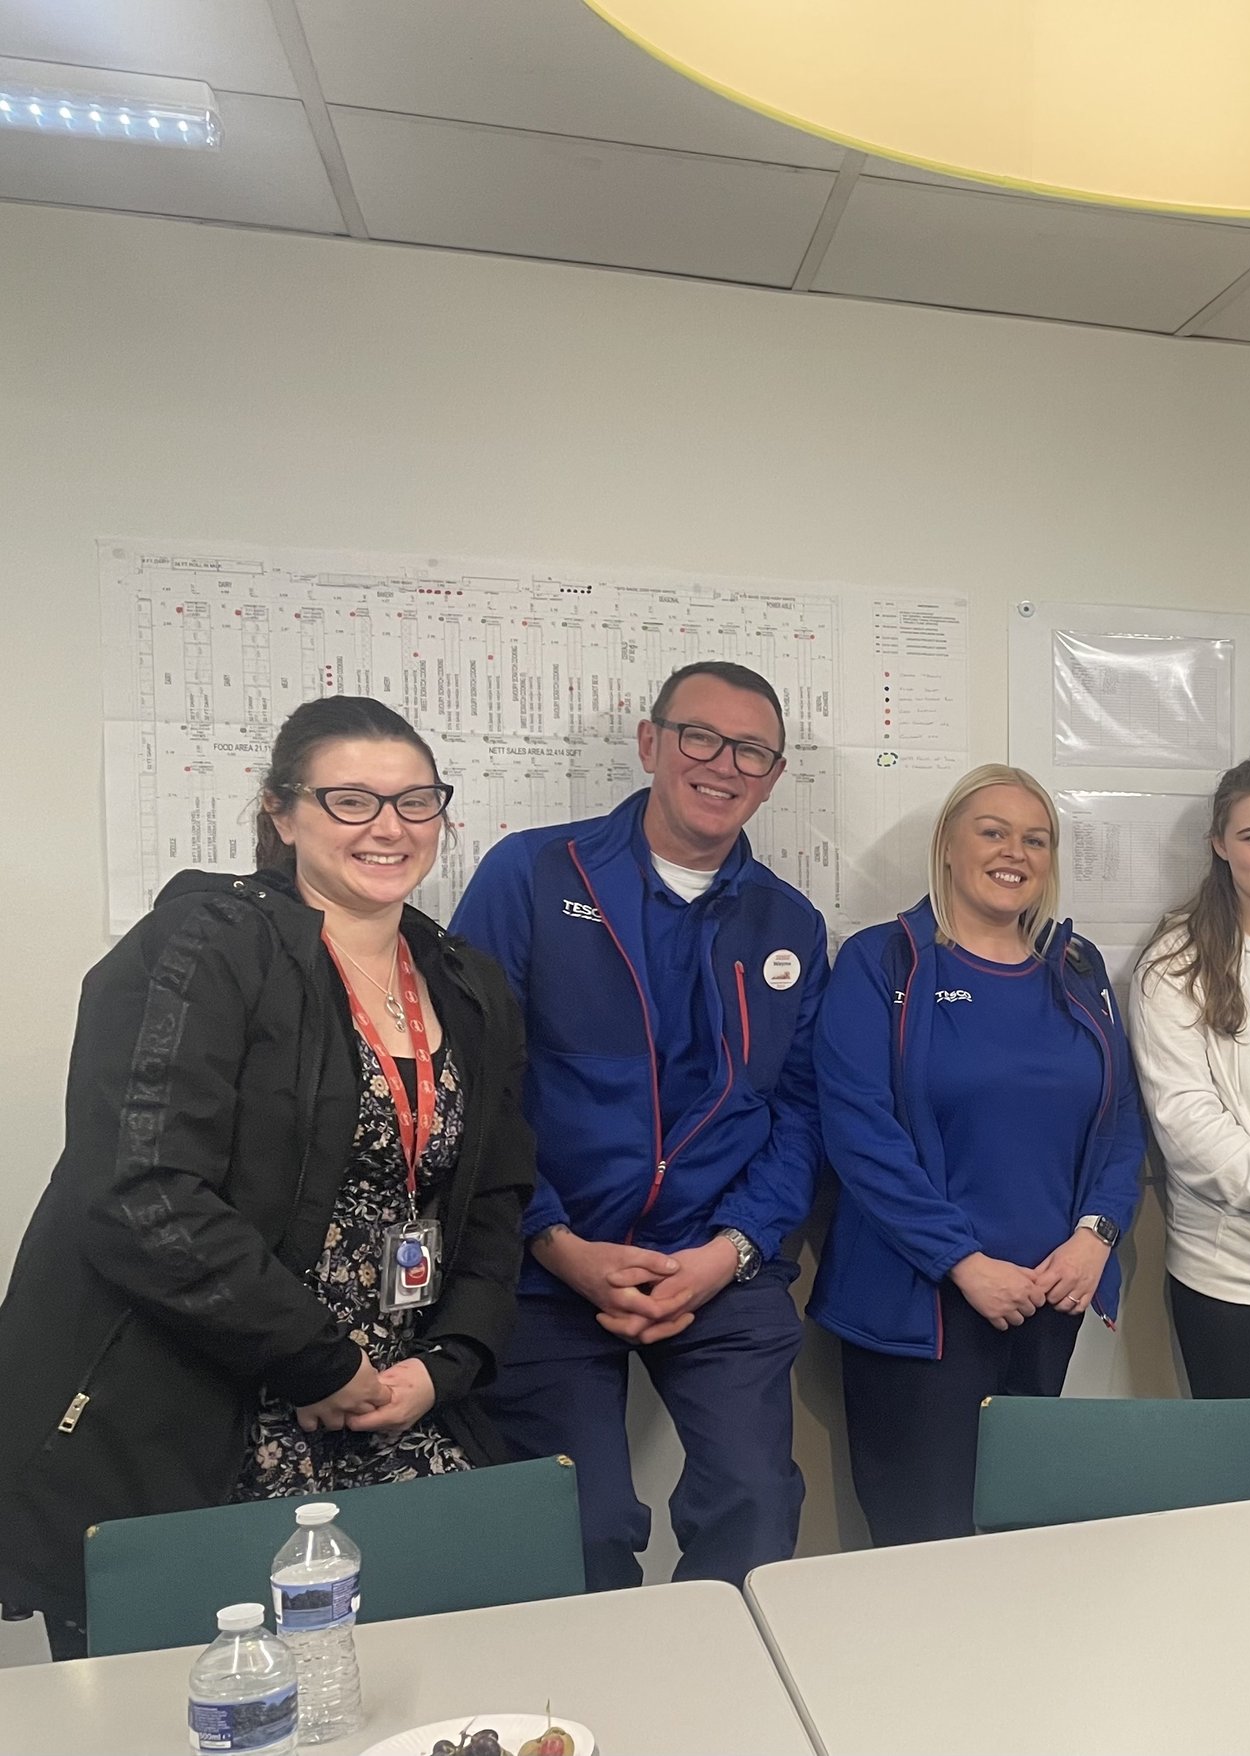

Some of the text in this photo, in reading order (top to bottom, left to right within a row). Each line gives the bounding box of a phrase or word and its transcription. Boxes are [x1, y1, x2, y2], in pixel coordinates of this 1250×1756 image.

[213, 743, 233, 751] FOOD
[234, 743, 253, 752] AREA
[488, 746, 505, 755] NETT
[506, 747, 527, 755] SALES
[527, 748, 545, 756] AREA
[563, 899, 604, 919] TESC
